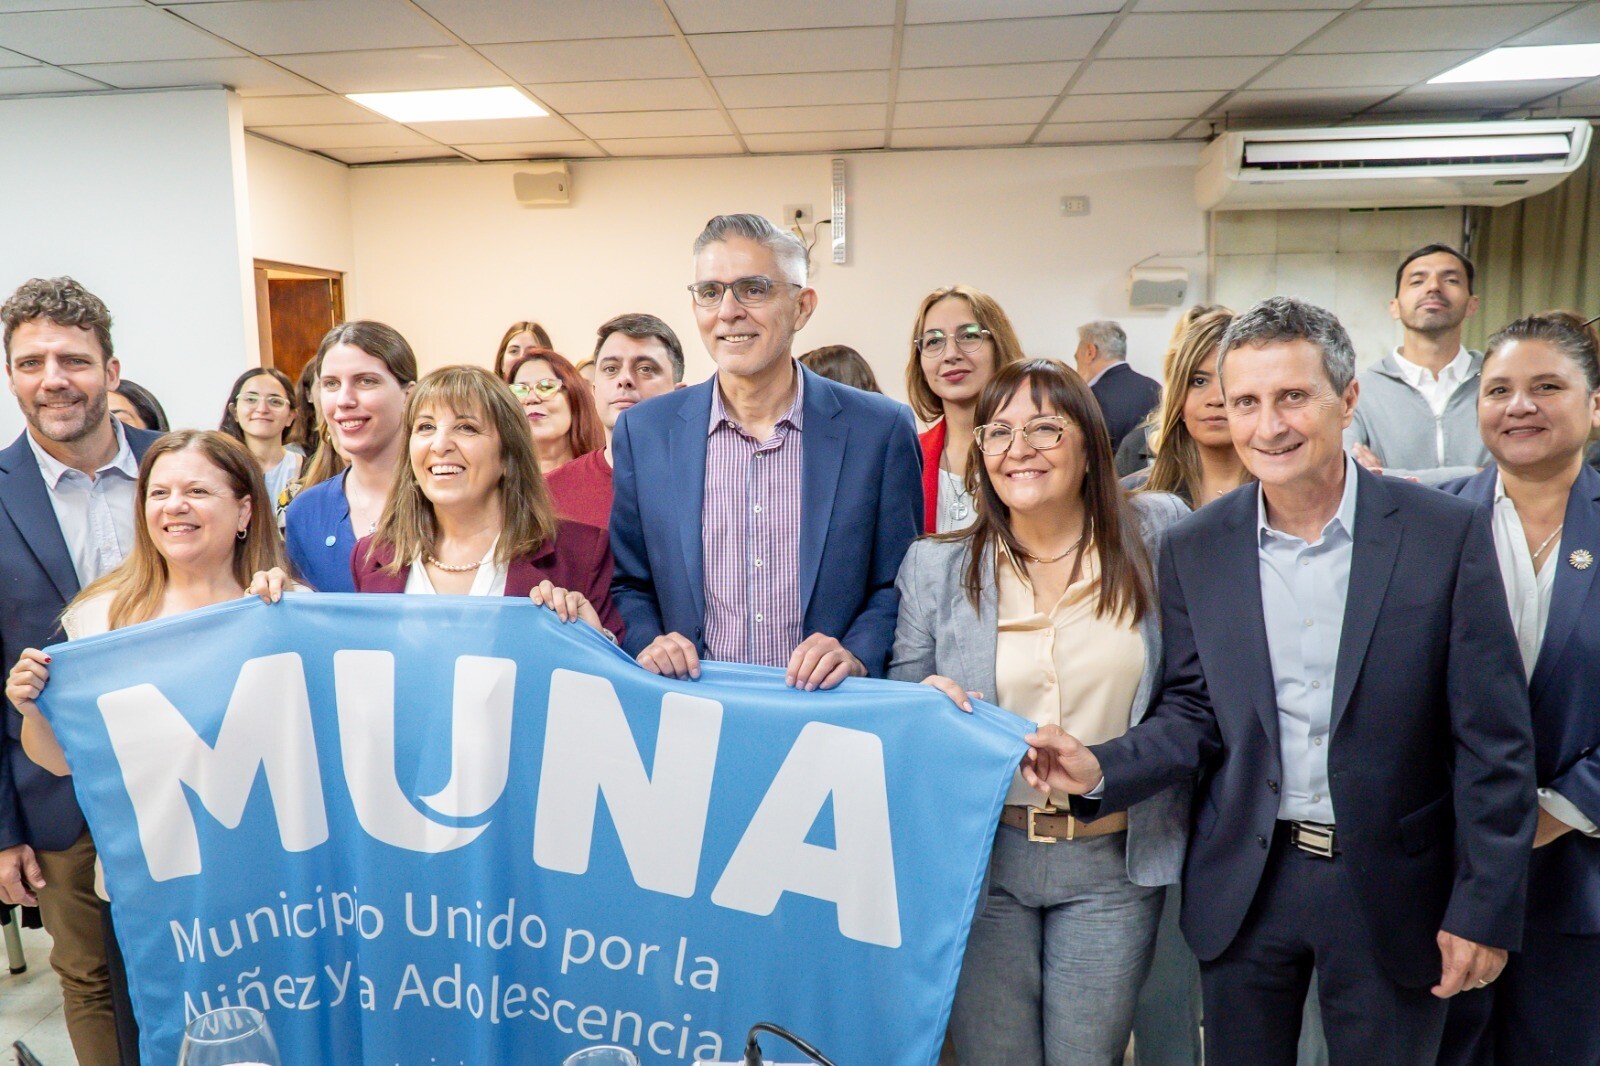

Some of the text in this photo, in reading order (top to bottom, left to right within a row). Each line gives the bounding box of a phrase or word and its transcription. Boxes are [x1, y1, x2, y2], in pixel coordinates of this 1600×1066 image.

[97, 650, 902, 949] MUNA
[169, 885, 720, 993] Municipio Unido por la
[183, 966, 321, 1030] Niñez
[324, 960, 352, 1007] y
[393, 963, 723, 1062] Adolescencia
